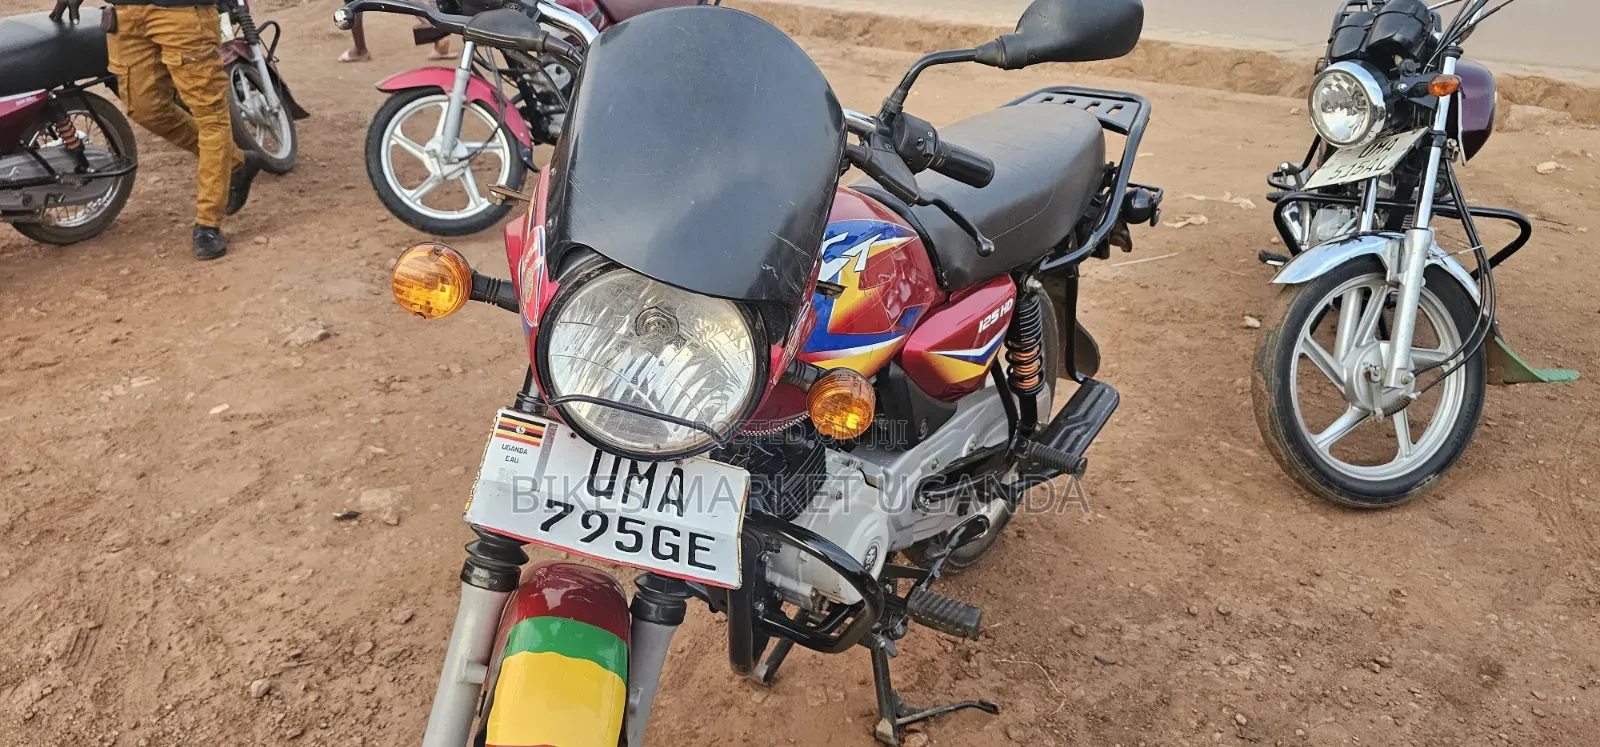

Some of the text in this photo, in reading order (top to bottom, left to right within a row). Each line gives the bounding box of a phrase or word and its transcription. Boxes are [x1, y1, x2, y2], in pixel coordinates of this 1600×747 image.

[978, 298, 1014, 334] 125 HD
[501, 443, 528, 455] UGANDA
[505, 454, 519, 464] EAU
[586, 450, 684, 518] UMA
[540, 498, 717, 572] 795GE
